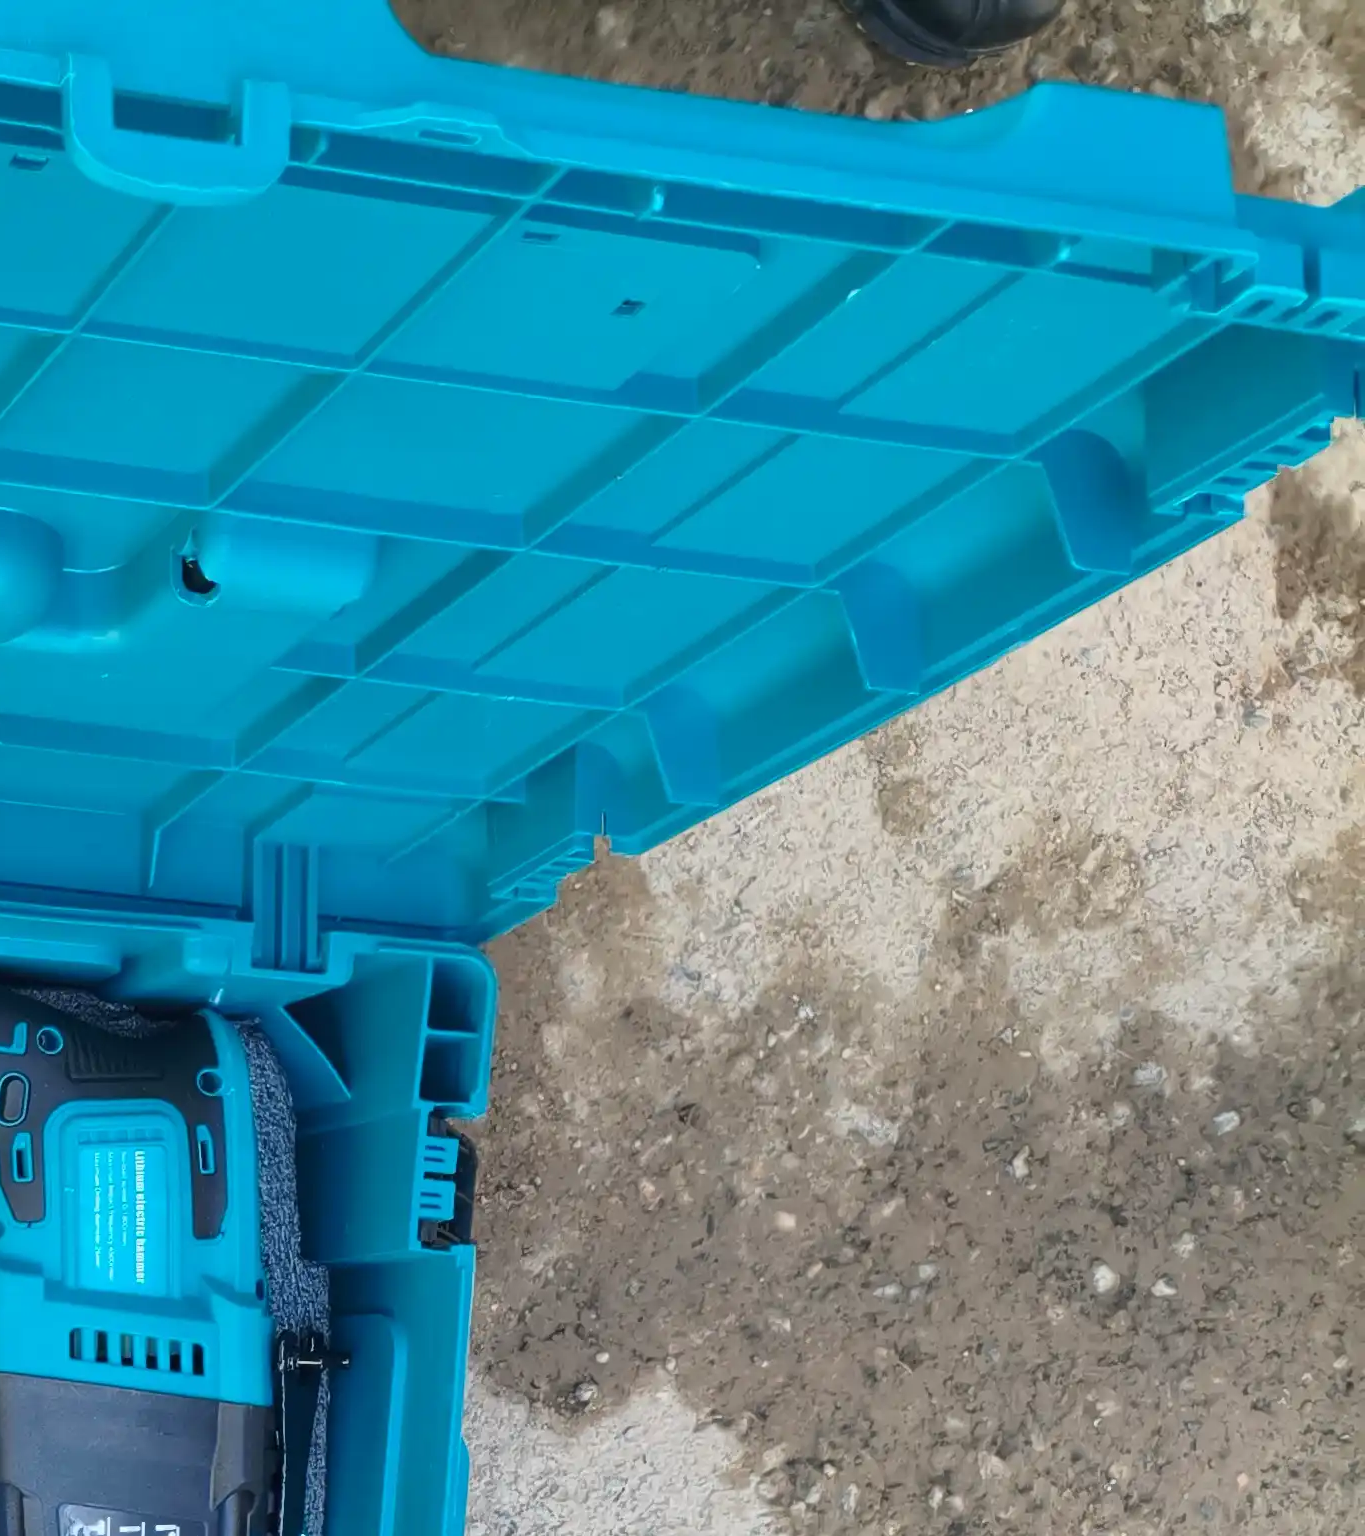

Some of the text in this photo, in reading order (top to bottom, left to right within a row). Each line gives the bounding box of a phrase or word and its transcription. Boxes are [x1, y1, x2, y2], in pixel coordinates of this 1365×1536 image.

[135, 1151, 147, 1284] Lithium electric hammer
